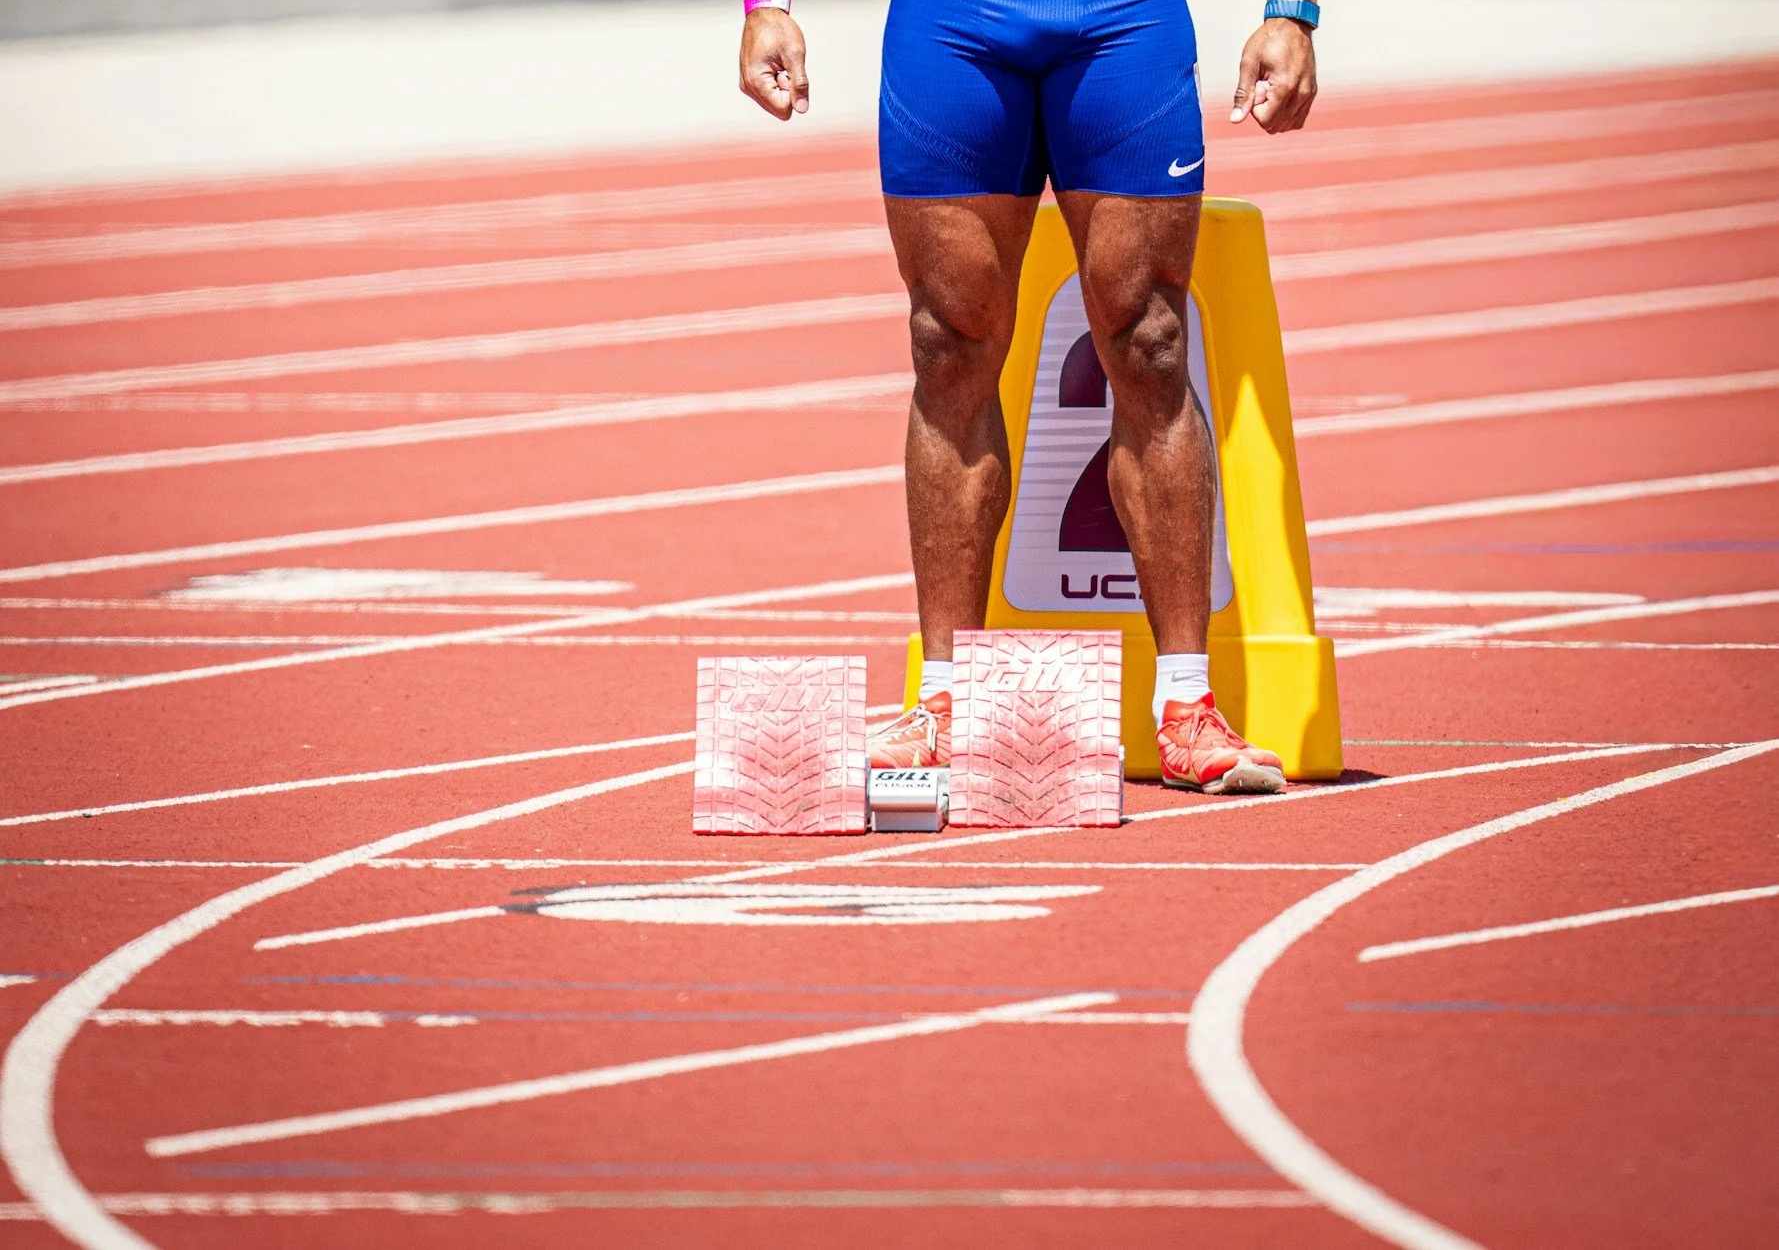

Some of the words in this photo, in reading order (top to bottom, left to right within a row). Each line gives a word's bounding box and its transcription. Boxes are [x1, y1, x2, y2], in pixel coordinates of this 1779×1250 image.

[1060, 573, 1145, 600] UC
[986, 667, 1088, 693] GILL
[729, 687, 832, 713] GILL
[876, 771, 931, 781] GILL
